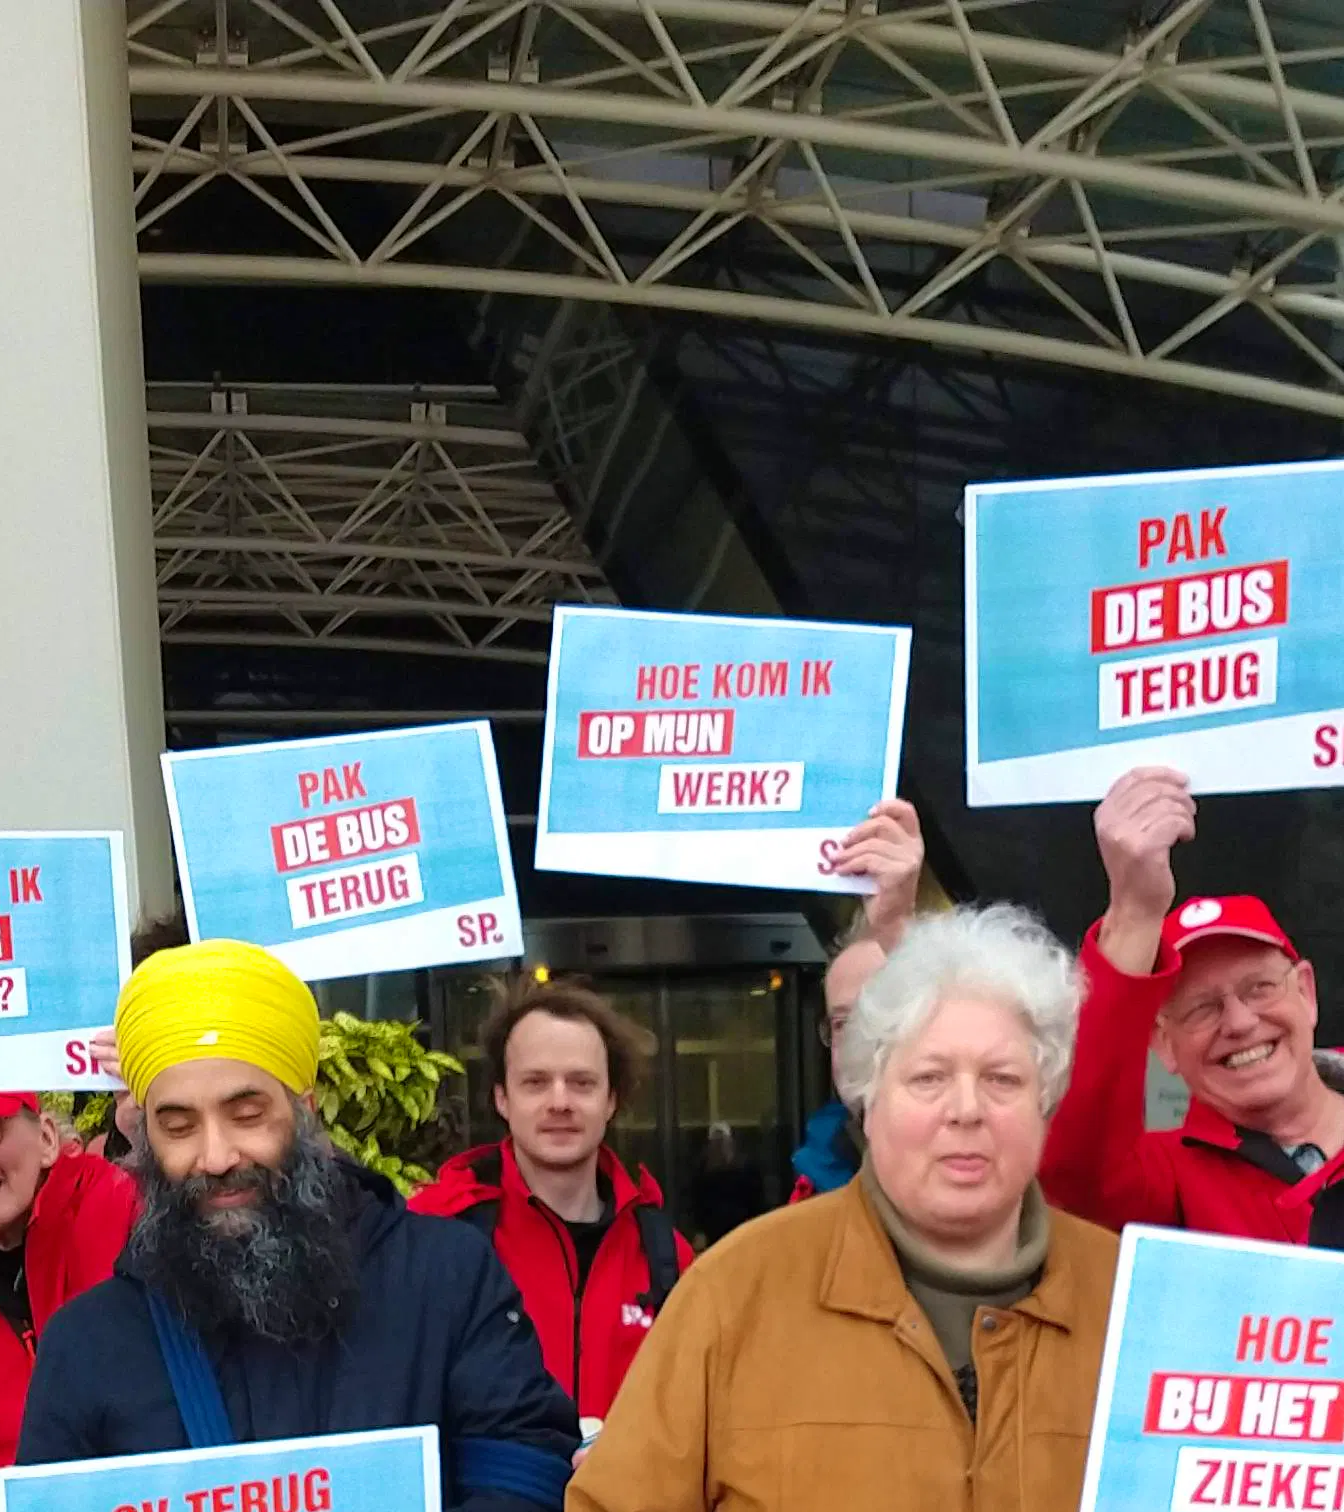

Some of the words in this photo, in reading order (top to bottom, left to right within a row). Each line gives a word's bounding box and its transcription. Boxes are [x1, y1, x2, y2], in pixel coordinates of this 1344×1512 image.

[1138, 506, 1228, 569] PAK
[1104, 588, 1164, 647] DE
[1178, 570, 1274, 636] BUS
[636, 664, 700, 701] HOE
[712, 661, 788, 698] KOM
[801, 660, 834, 696] IK
[1116, 652, 1260, 718] TERUG
[587, 715, 634, 755] OP
[643, 713, 725, 754] MIJN
[298, 760, 368, 809] PAK
[672, 769, 791, 807] WERK?
[281, 820, 329, 867] DE
[336, 805, 410, 857] BUS
[9, 866, 43, 904] IK
[299, 864, 410, 919] TERUG
[1235, 1314, 1334, 1366] HOE
[1158, 1377, 1232, 1434] BIJ
[1239, 1381, 1339, 1438] HET
